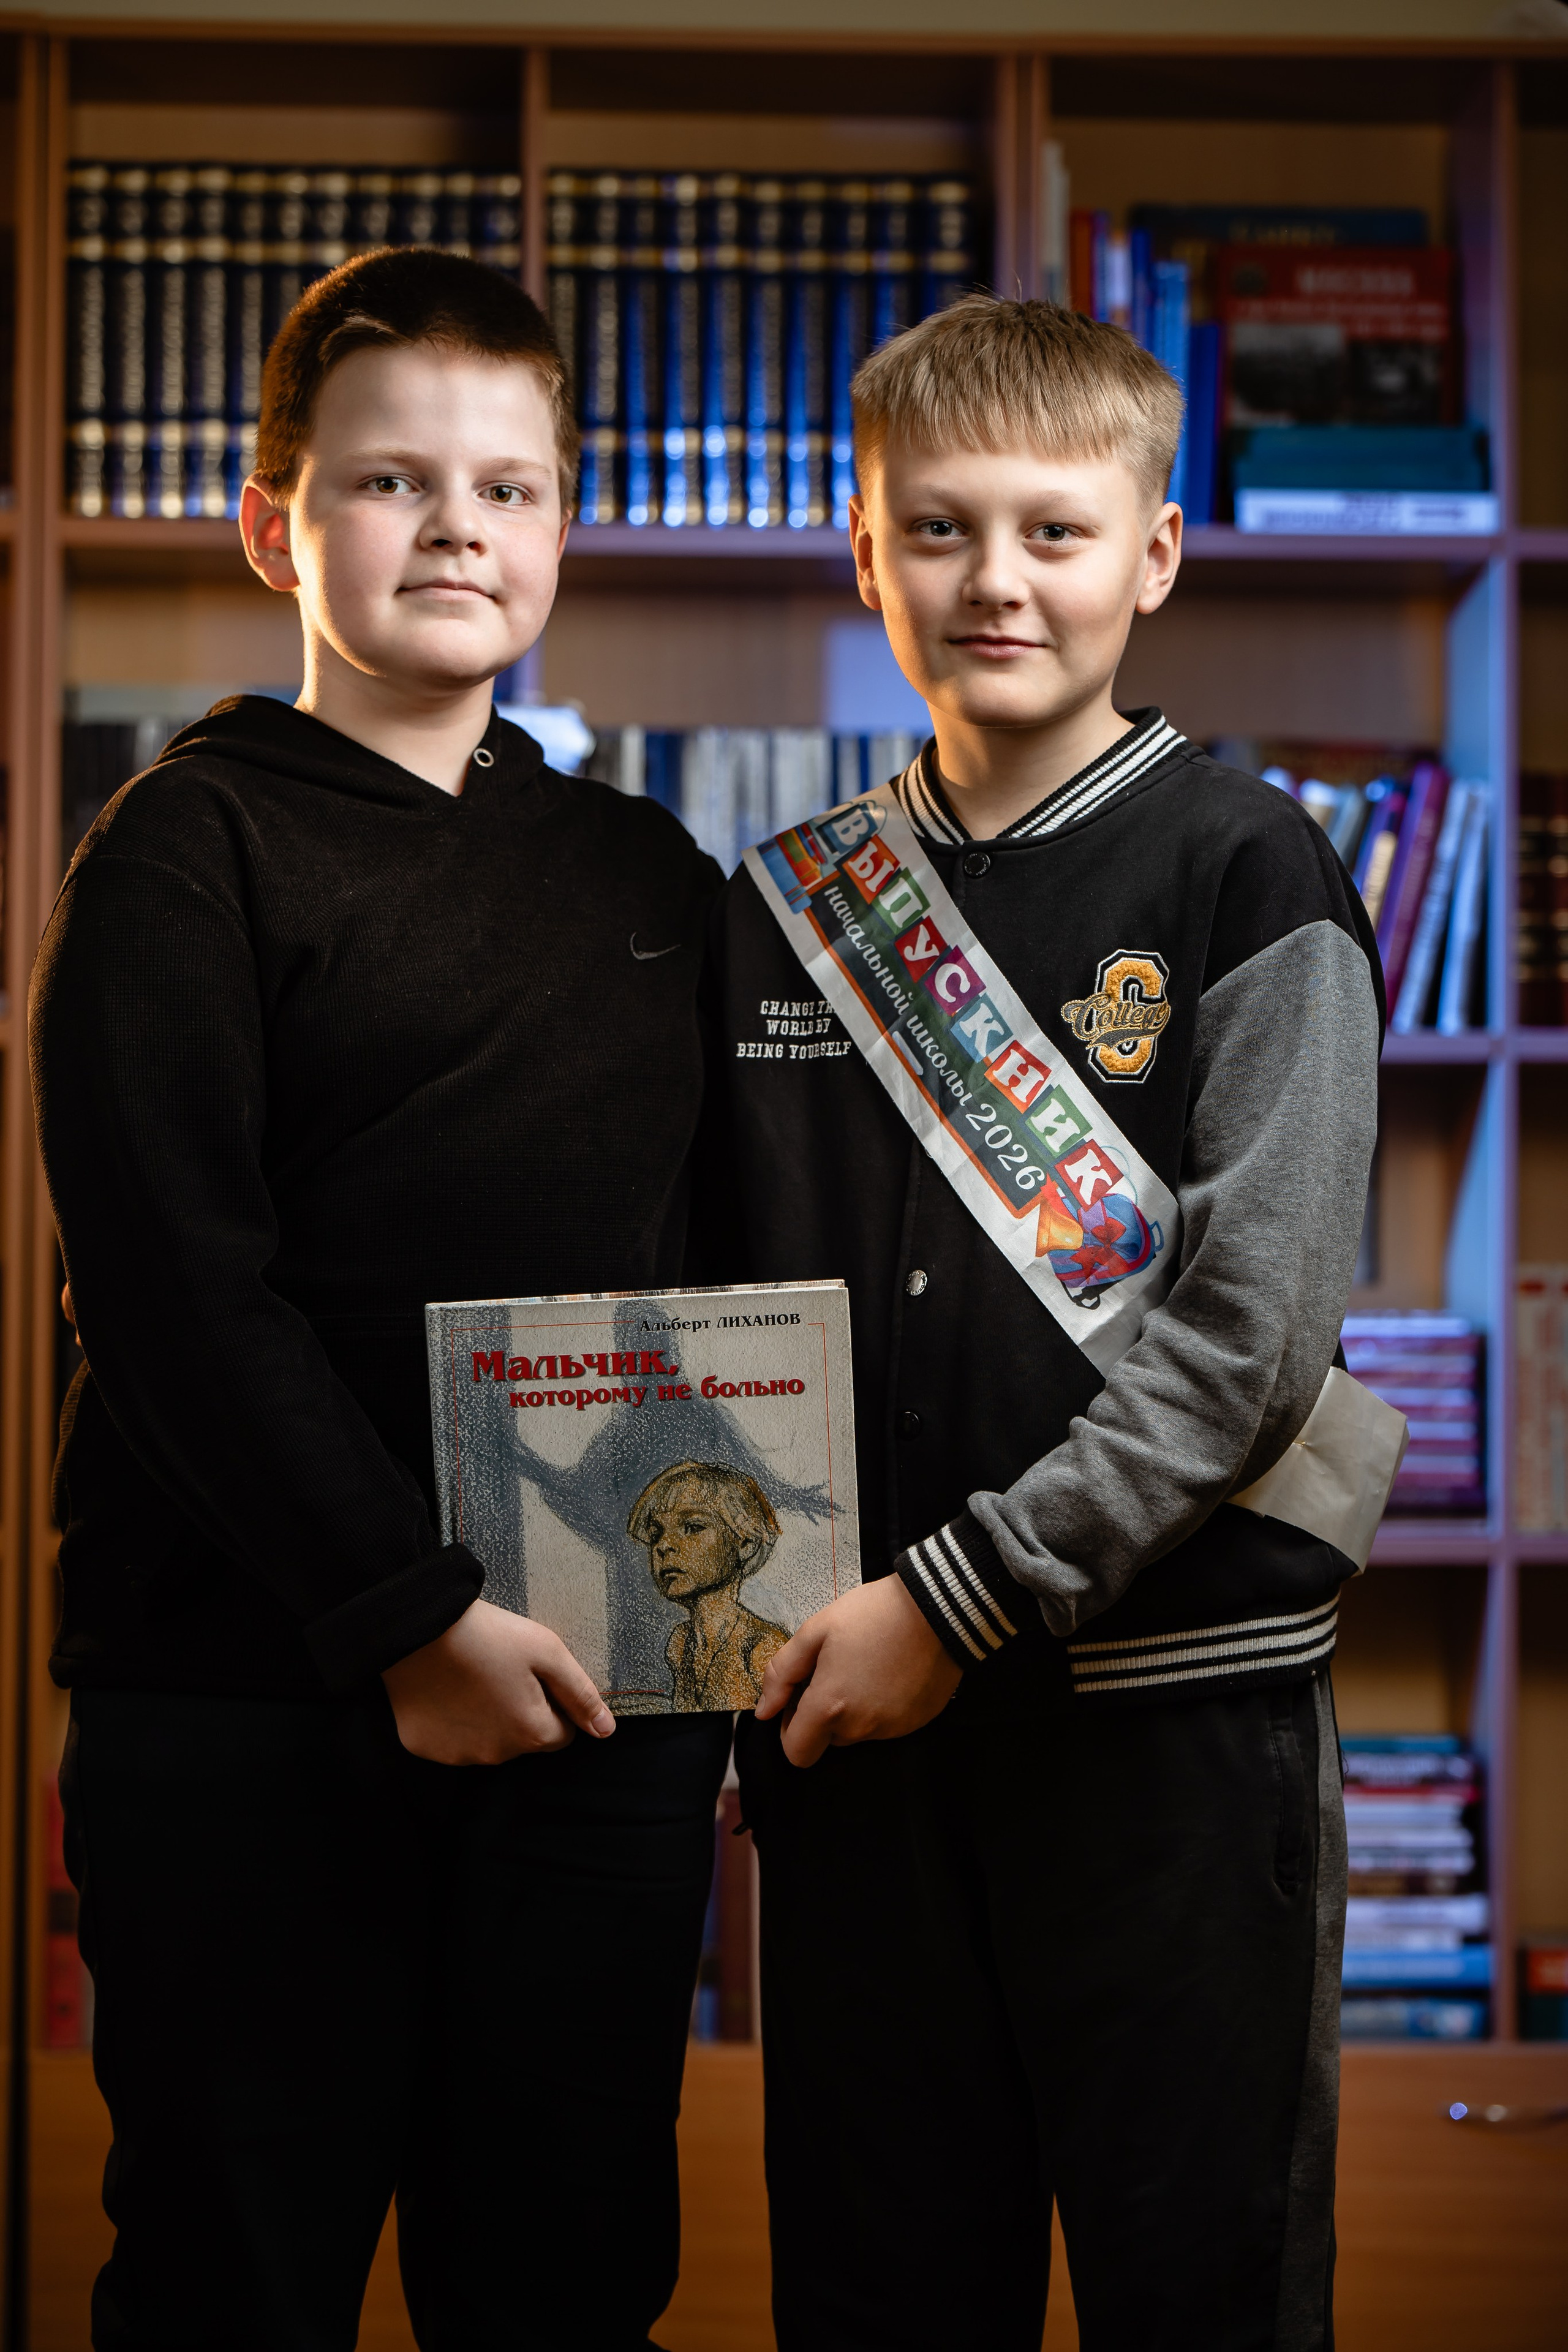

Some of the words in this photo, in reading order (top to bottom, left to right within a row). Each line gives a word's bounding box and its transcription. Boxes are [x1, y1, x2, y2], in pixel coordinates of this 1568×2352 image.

[831, 808, 1113, 1205] ВЫПУСКНИК
[766, 1019, 814, 1036] WORLD
[815, 1018, 832, 1033] BY
[824, 886, 913, 1016] начальной
[907, 1014, 973, 1106] школы
[965, 1103, 1045, 1189] 2026
[736, 1042, 783, 1058] BEING
[789, 1041, 851, 1059] YOURSELF
[639, 1317, 710, 1332] Альберт
[717, 1313, 801, 1329] ЛИХАНОВ
[471, 1349, 679, 1382] Мальчик,
[508, 1385, 648, 1411] которому
[657, 1383, 693, 1401] не
[700, 1374, 805, 1399] больно
